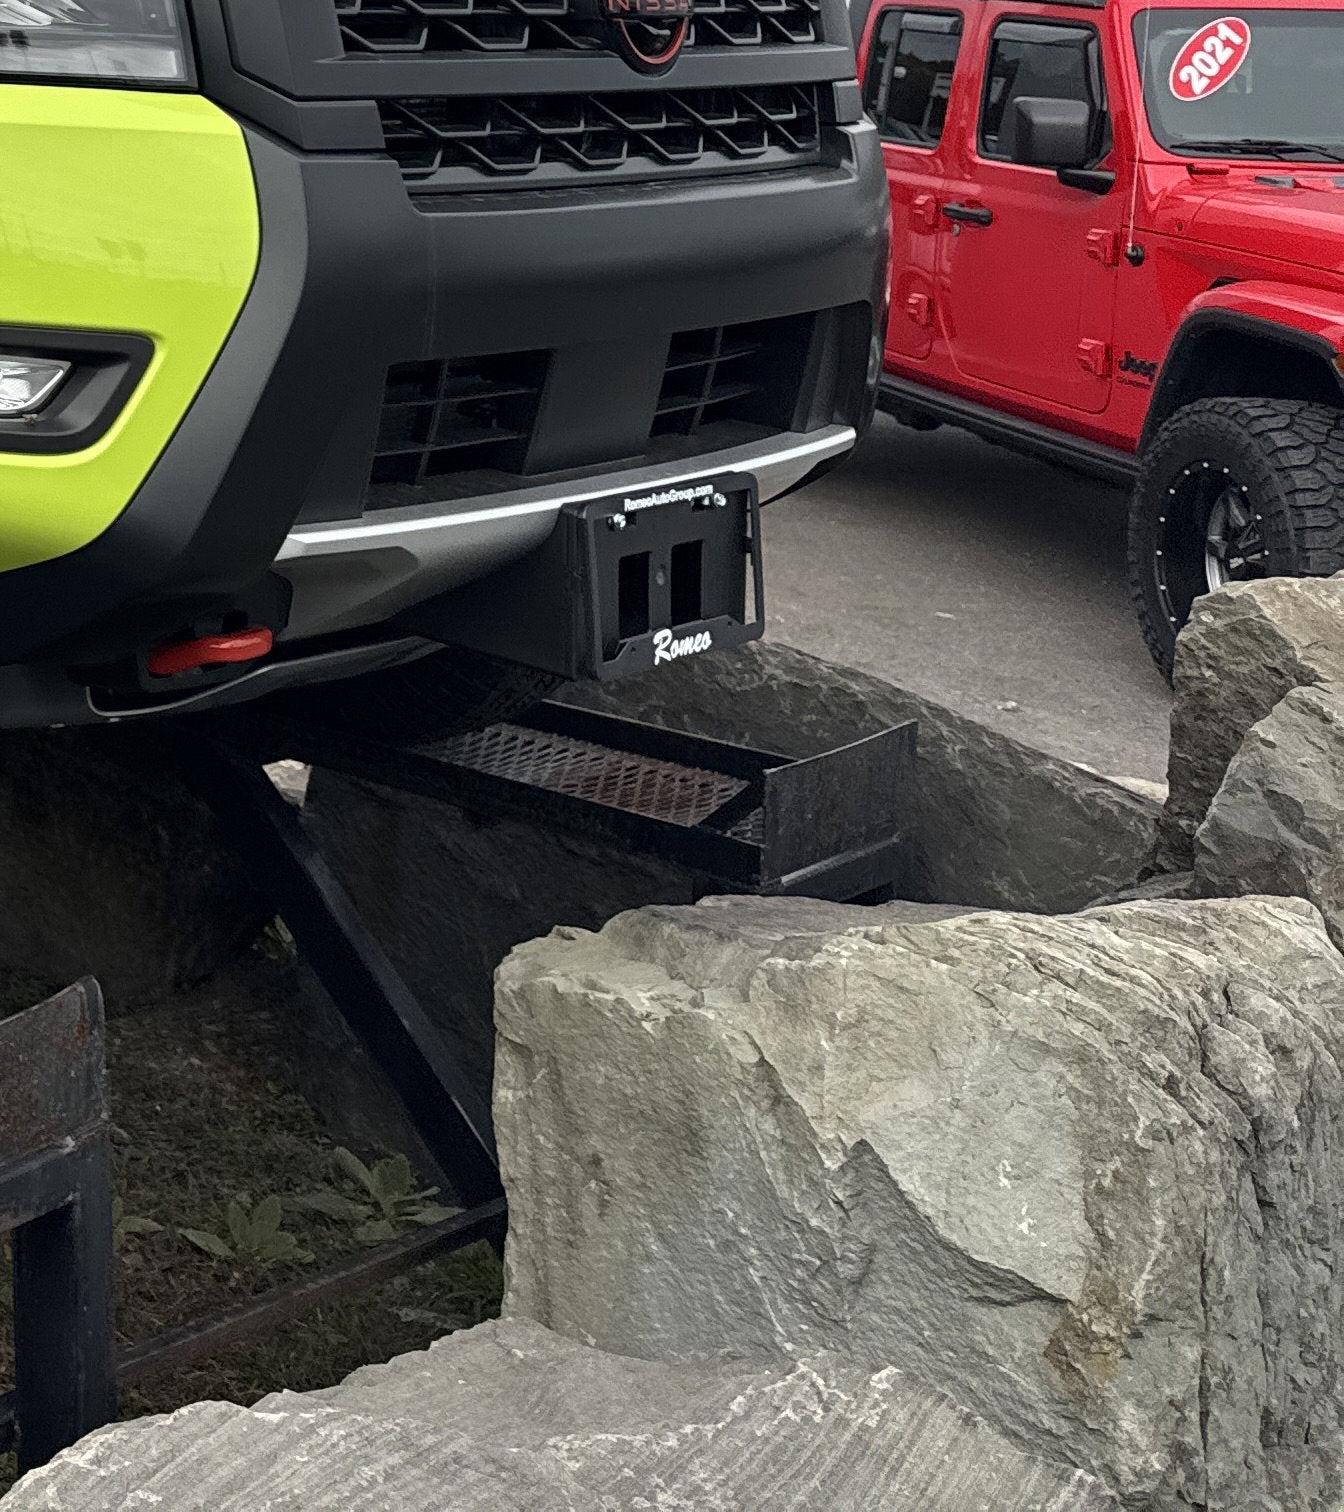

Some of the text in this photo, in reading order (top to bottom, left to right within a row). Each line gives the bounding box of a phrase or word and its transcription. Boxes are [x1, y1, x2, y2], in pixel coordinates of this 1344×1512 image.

[1179, 22, 1243, 95] 2021
[624, 484, 714, 512] RomeoAutoGroup.com
[653, 628, 712, 666] Romeo
